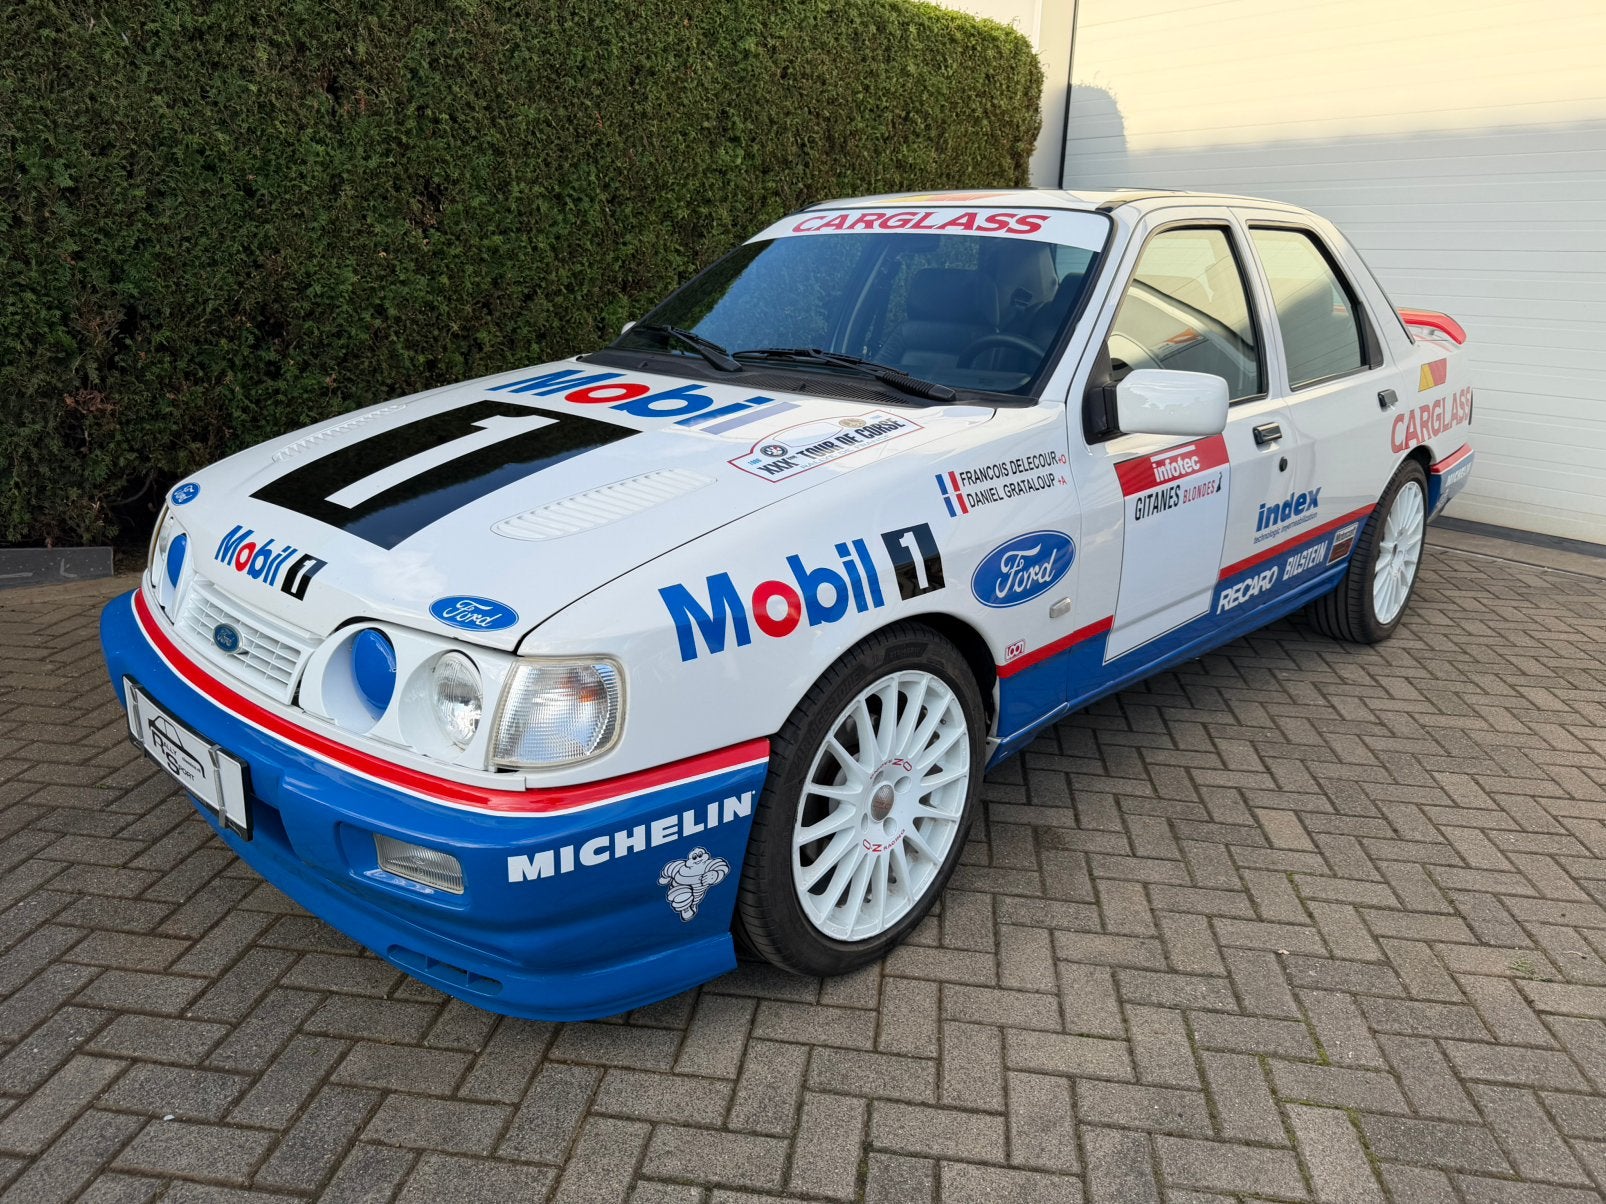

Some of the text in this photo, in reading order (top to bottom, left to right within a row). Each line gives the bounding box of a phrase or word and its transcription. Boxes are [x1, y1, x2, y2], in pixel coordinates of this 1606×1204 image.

[791, 210, 1051, 235] CARGLASS
[795, 440, 839, 460] TOUR
[834, 430, 861, 449] DE
[854, 417, 906, 440] CORSE
[1391, 386, 1471, 454] CARGLASS
[325, 414, 561, 509] 1
[959, 462, 1009, 487] FRANCOIS
[1009, 450, 1059, 476] DELECOUR
[1152, 455, 1201, 483] infotec
[966, 486, 1005, 509] DANIEL
[1003, 472, 1056, 499] GRATALOUP
[1134, 480, 1216, 521] GITANES BLONDES
[1256, 486, 1322, 533] index
[214, 525, 319, 594] Mobil 1
[996, 543, 1057, 599] Ford
[1216, 540, 1328, 615] RECARO BILSTEIN
[442, 599, 503, 628] Ford
[657, 531, 930, 663] Mobil 1
[507, 792, 752, 883] MICHELIN
